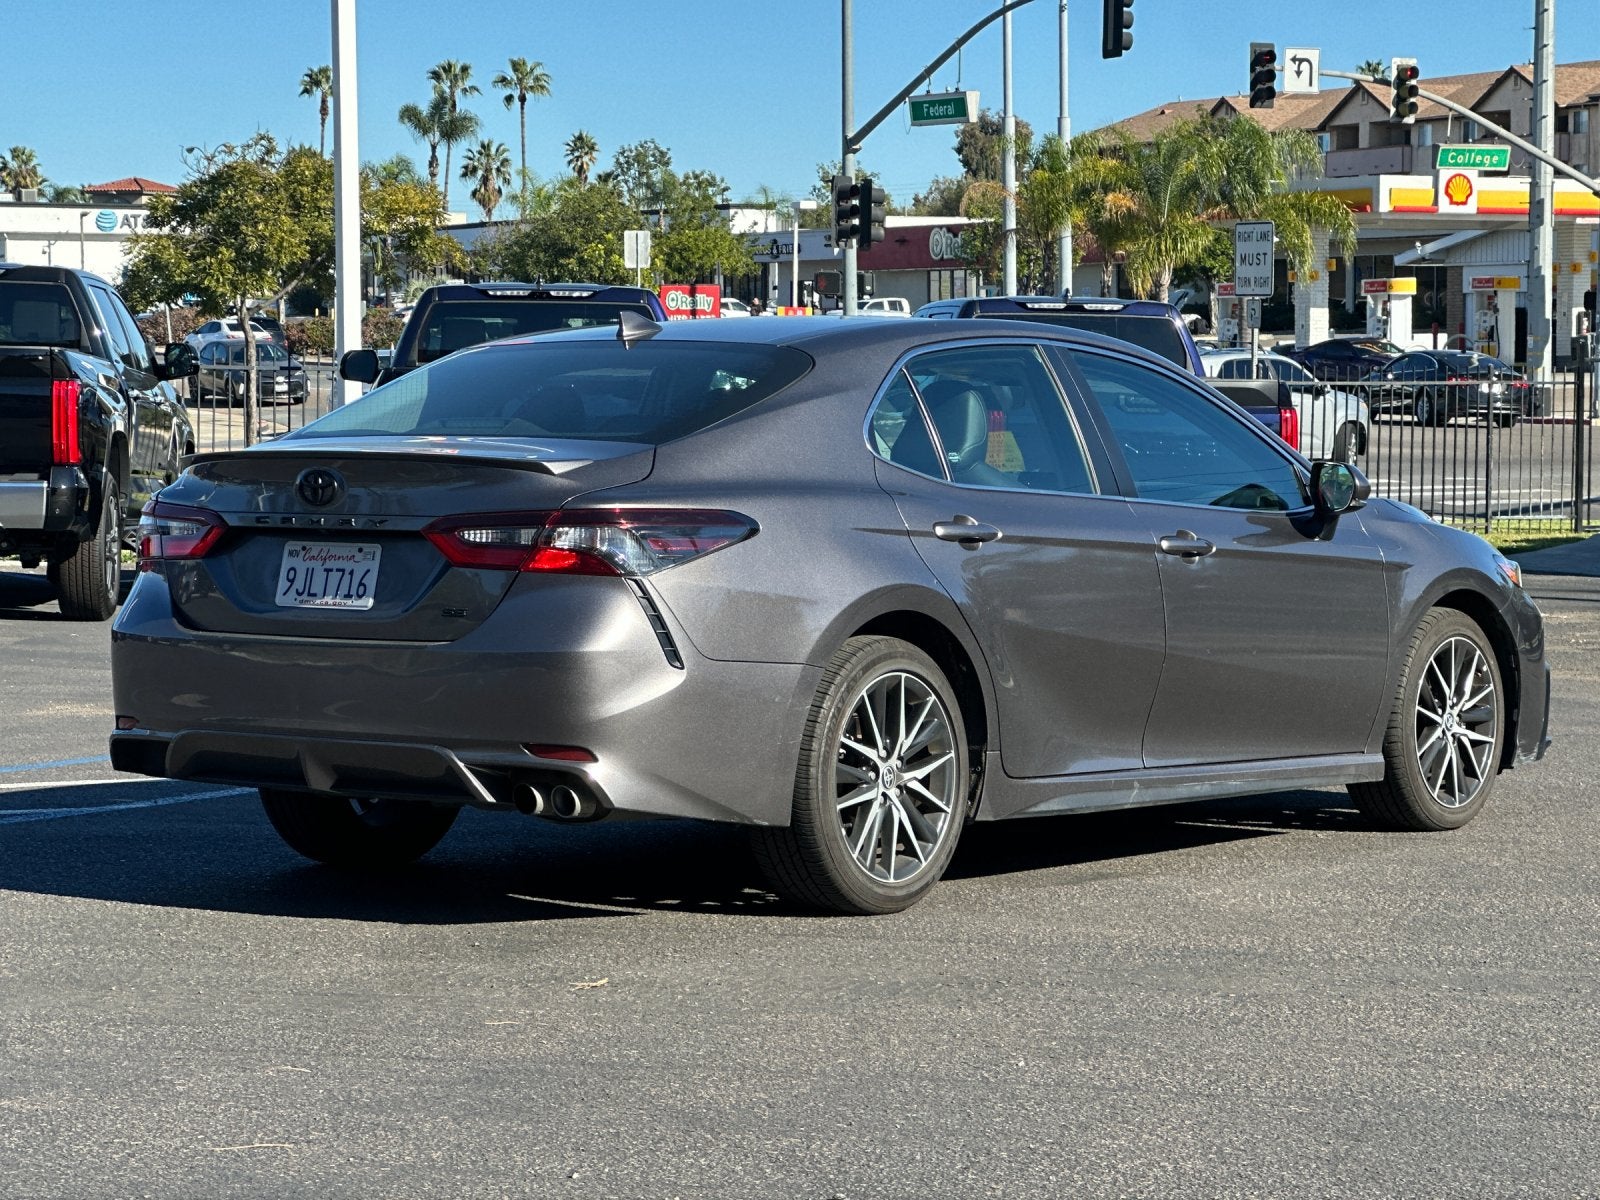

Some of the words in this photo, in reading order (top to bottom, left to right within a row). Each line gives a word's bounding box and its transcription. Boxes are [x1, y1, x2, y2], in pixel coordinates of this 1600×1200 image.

[923, 102, 955, 117] Federal
[1448, 152, 1499, 167] College
[1237, 231, 1254, 243] RIGHT
[1256, 230, 1271, 242] LANE
[1240, 252, 1268, 266] MUST
[1237, 276, 1252, 288] TURN
[1254, 276, 1270, 288] RIGHT
[666, 291, 714, 312] O'Reilly
[255, 515, 389, 527] CAMRY
[288, 549, 300, 558] NOV
[302, 547, 360, 567] California
[282, 566, 371, 598] 9JLT716
[299, 598, 348, 607] dmv.ca.gov
